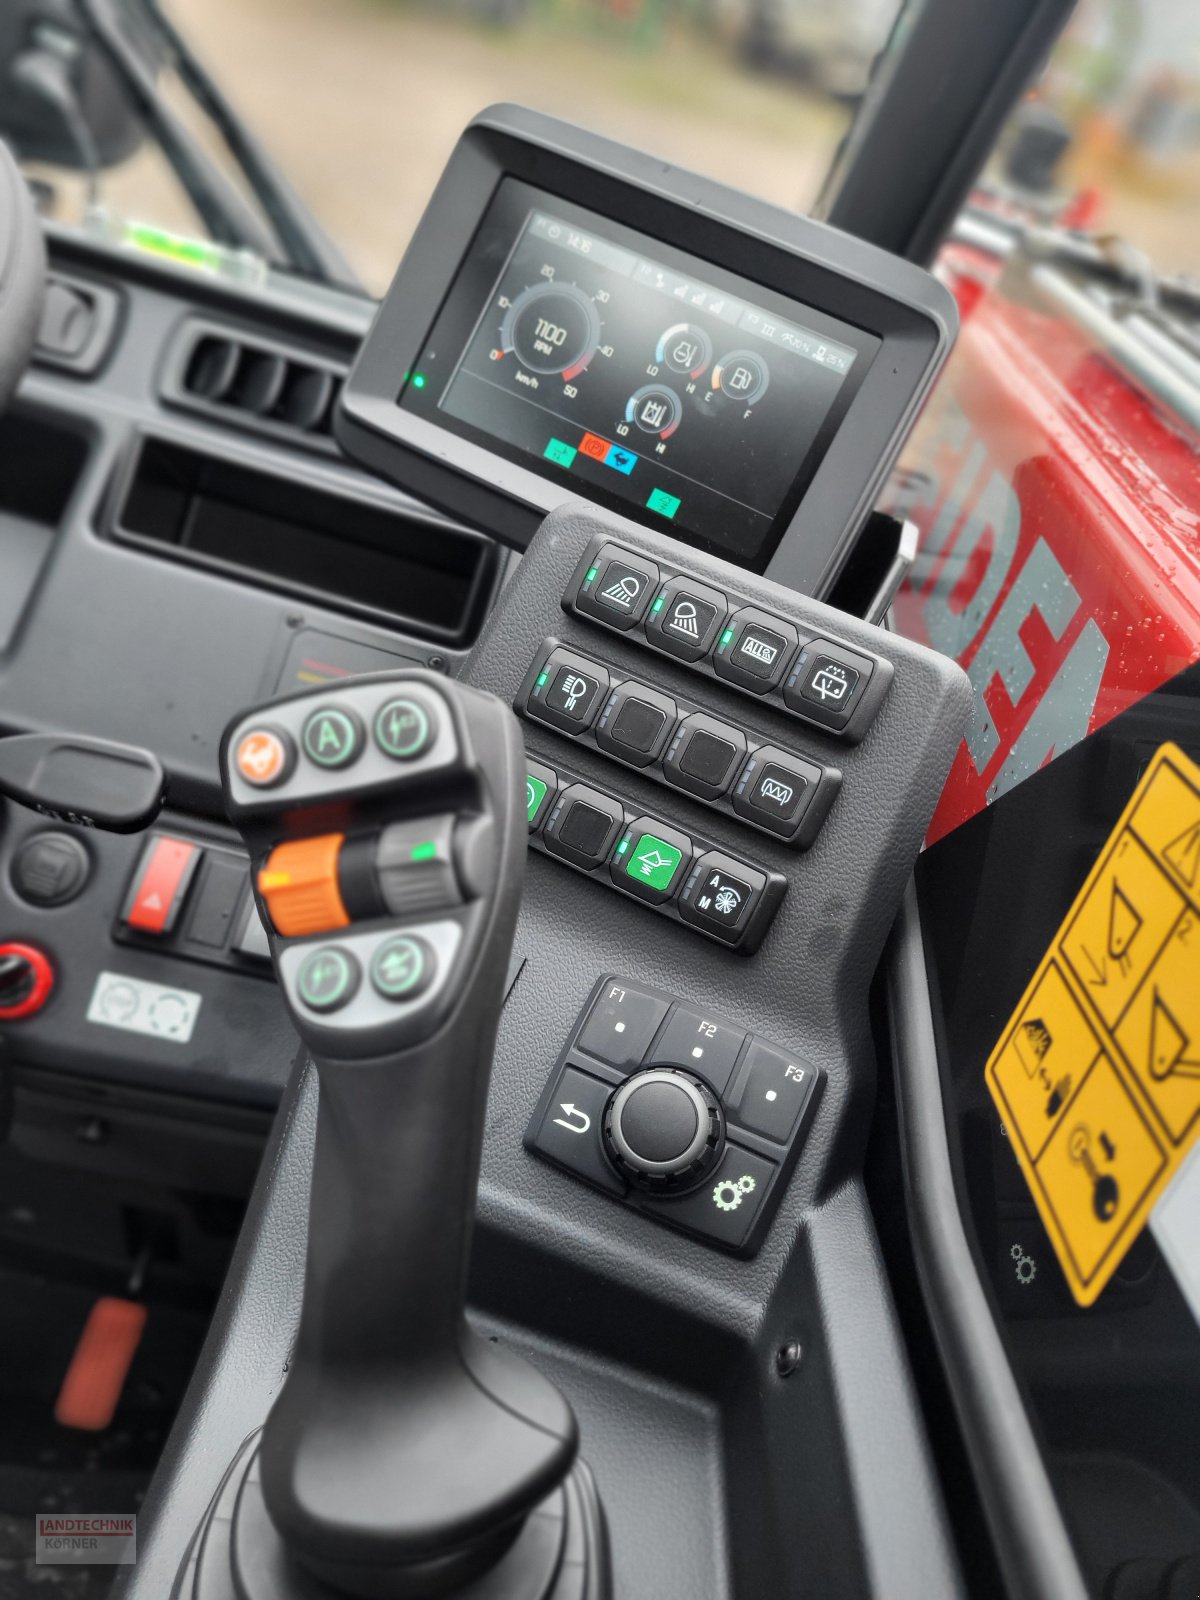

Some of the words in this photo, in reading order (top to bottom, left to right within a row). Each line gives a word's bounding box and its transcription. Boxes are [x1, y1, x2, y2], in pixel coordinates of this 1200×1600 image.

[540, 264, 555, 278] 20
[498, 295, 510, 308] 10
[596, 289, 610, 303] 30
[534, 318, 567, 346] 1100
[489, 348, 498, 360] 0
[533, 339, 553, 356] RPM
[600, 344, 614, 358] 40
[646, 364, 659, 377] LO
[515, 370, 539, 389] km/h
[563, 384, 578, 398] 50
[685, 382, 696, 395] HI
[704, 391, 713, 402] E
[743, 409, 752, 420] F
[616, 423, 629, 436] LO
[655, 442, 666, 454] HI
[745, 640, 763, 656] ALL
[318, 718, 341, 752] A
[709, 874, 720, 888] A
[698, 895, 711, 910] M
[1178, 918, 1193, 946] 2
[609, 986, 626, 1003] F1
[698, 1020, 717, 1038] F2
[784, 1064, 805, 1082] F3
